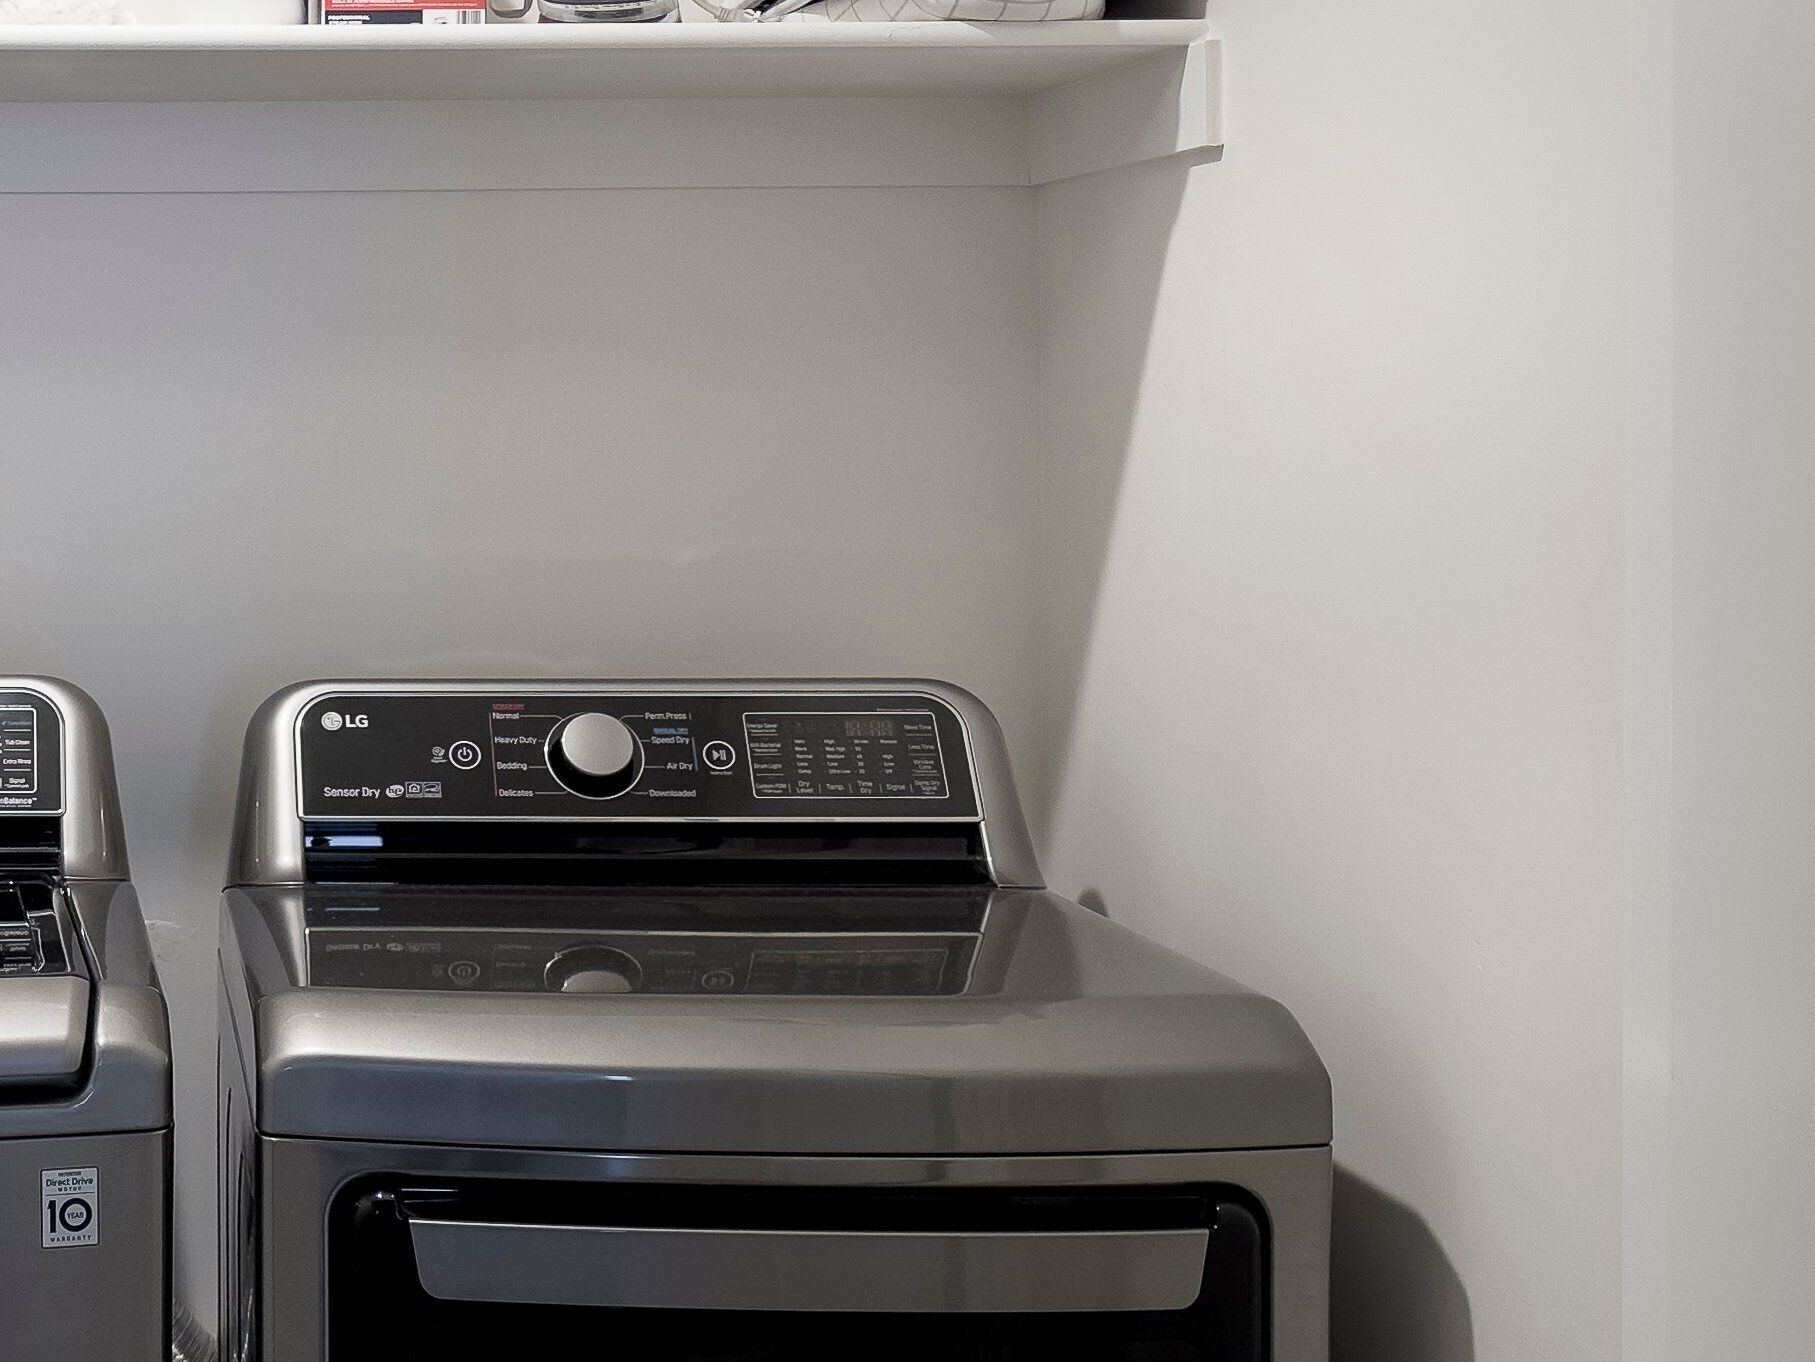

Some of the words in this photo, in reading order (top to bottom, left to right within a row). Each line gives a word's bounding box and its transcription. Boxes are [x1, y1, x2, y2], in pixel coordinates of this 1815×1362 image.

[346, 714, 369, 727] LG
[495, 737, 518, 745] Heavy
[519, 737, 537, 745] Duty
[651, 736, 675, 745] Speed
[676, 736, 690, 745] Dry
[497, 763, 527, 771] Bedding
[678, 763, 692, 771] Dry
[324, 787, 360, 797] Sensor
[362, 787, 380, 798] Dry
[46, 1179, 70, 1187] Direct
[47, 1198, 92, 1233] 10
